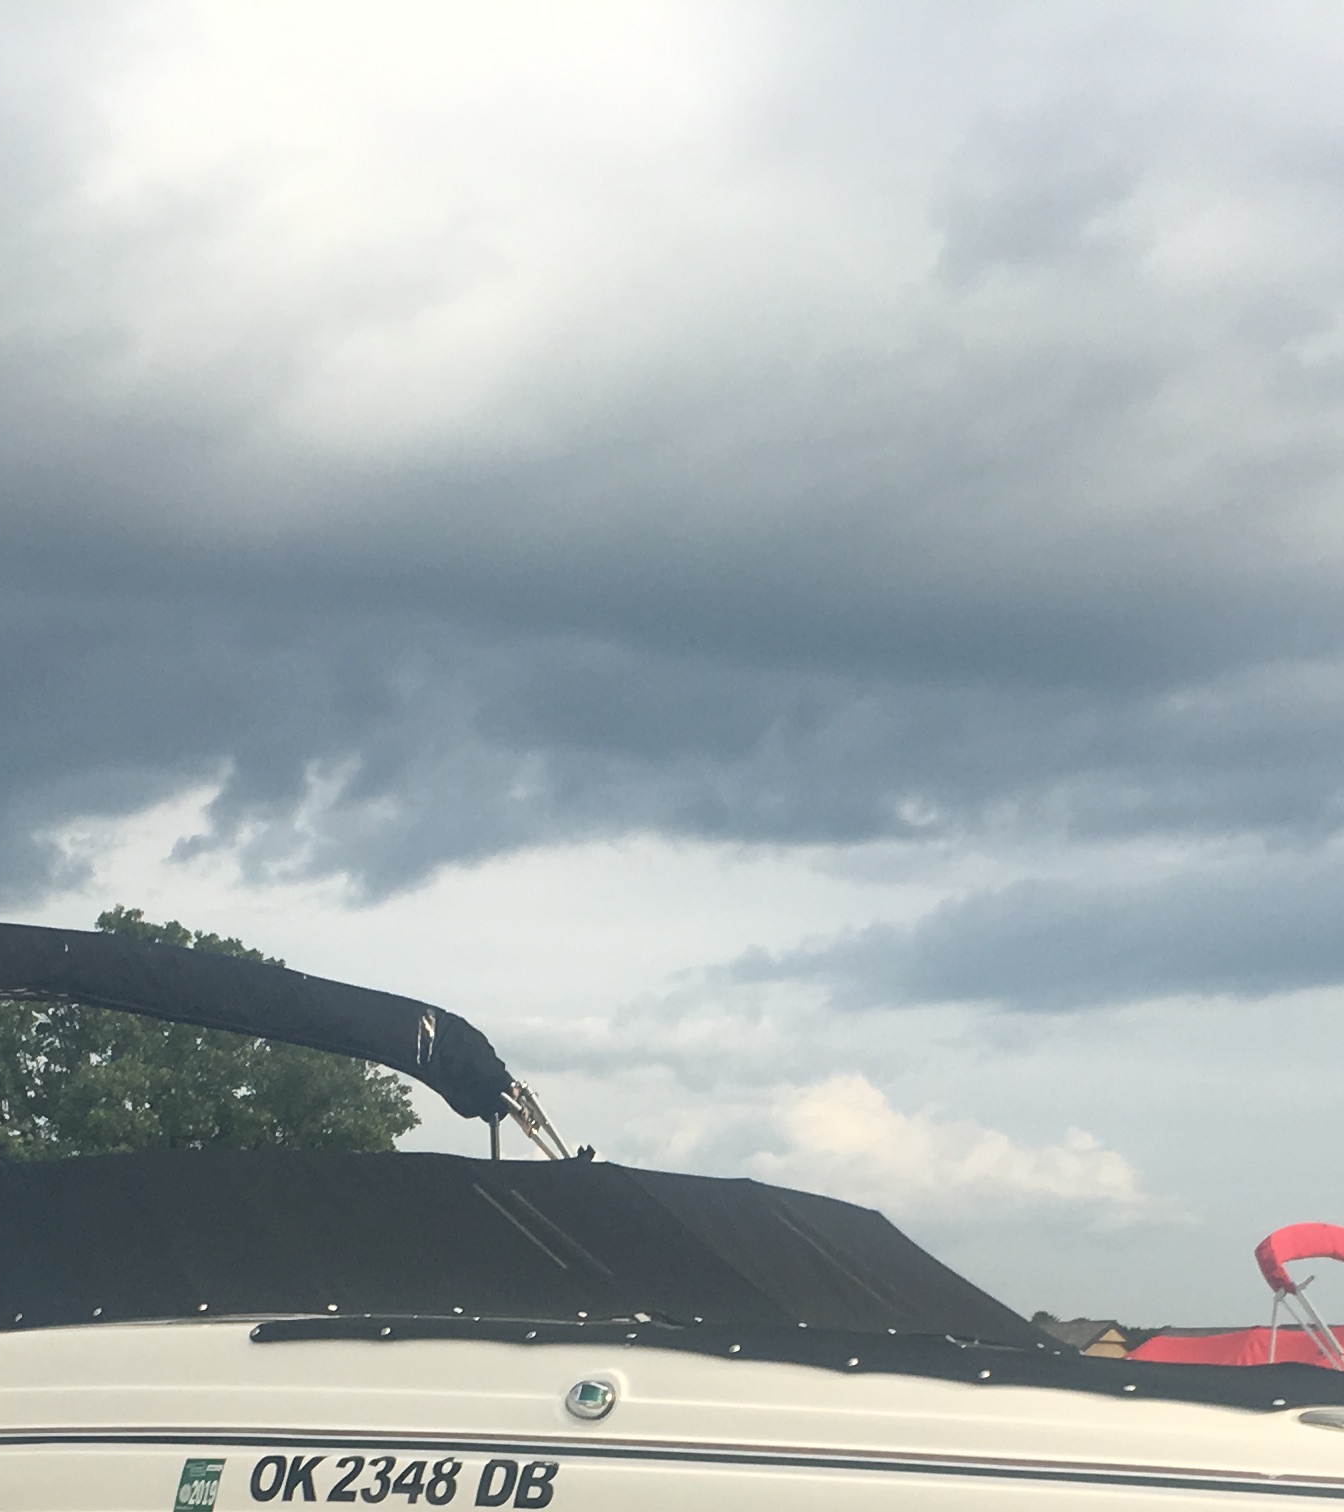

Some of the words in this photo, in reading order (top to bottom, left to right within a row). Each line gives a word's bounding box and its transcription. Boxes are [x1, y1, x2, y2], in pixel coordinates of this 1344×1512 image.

[187, 1479, 219, 1506] 2019
[250, 1455, 327, 1503] OK
[326, 1456, 463, 1506] 2348
[474, 1458, 560, 1510] DB
